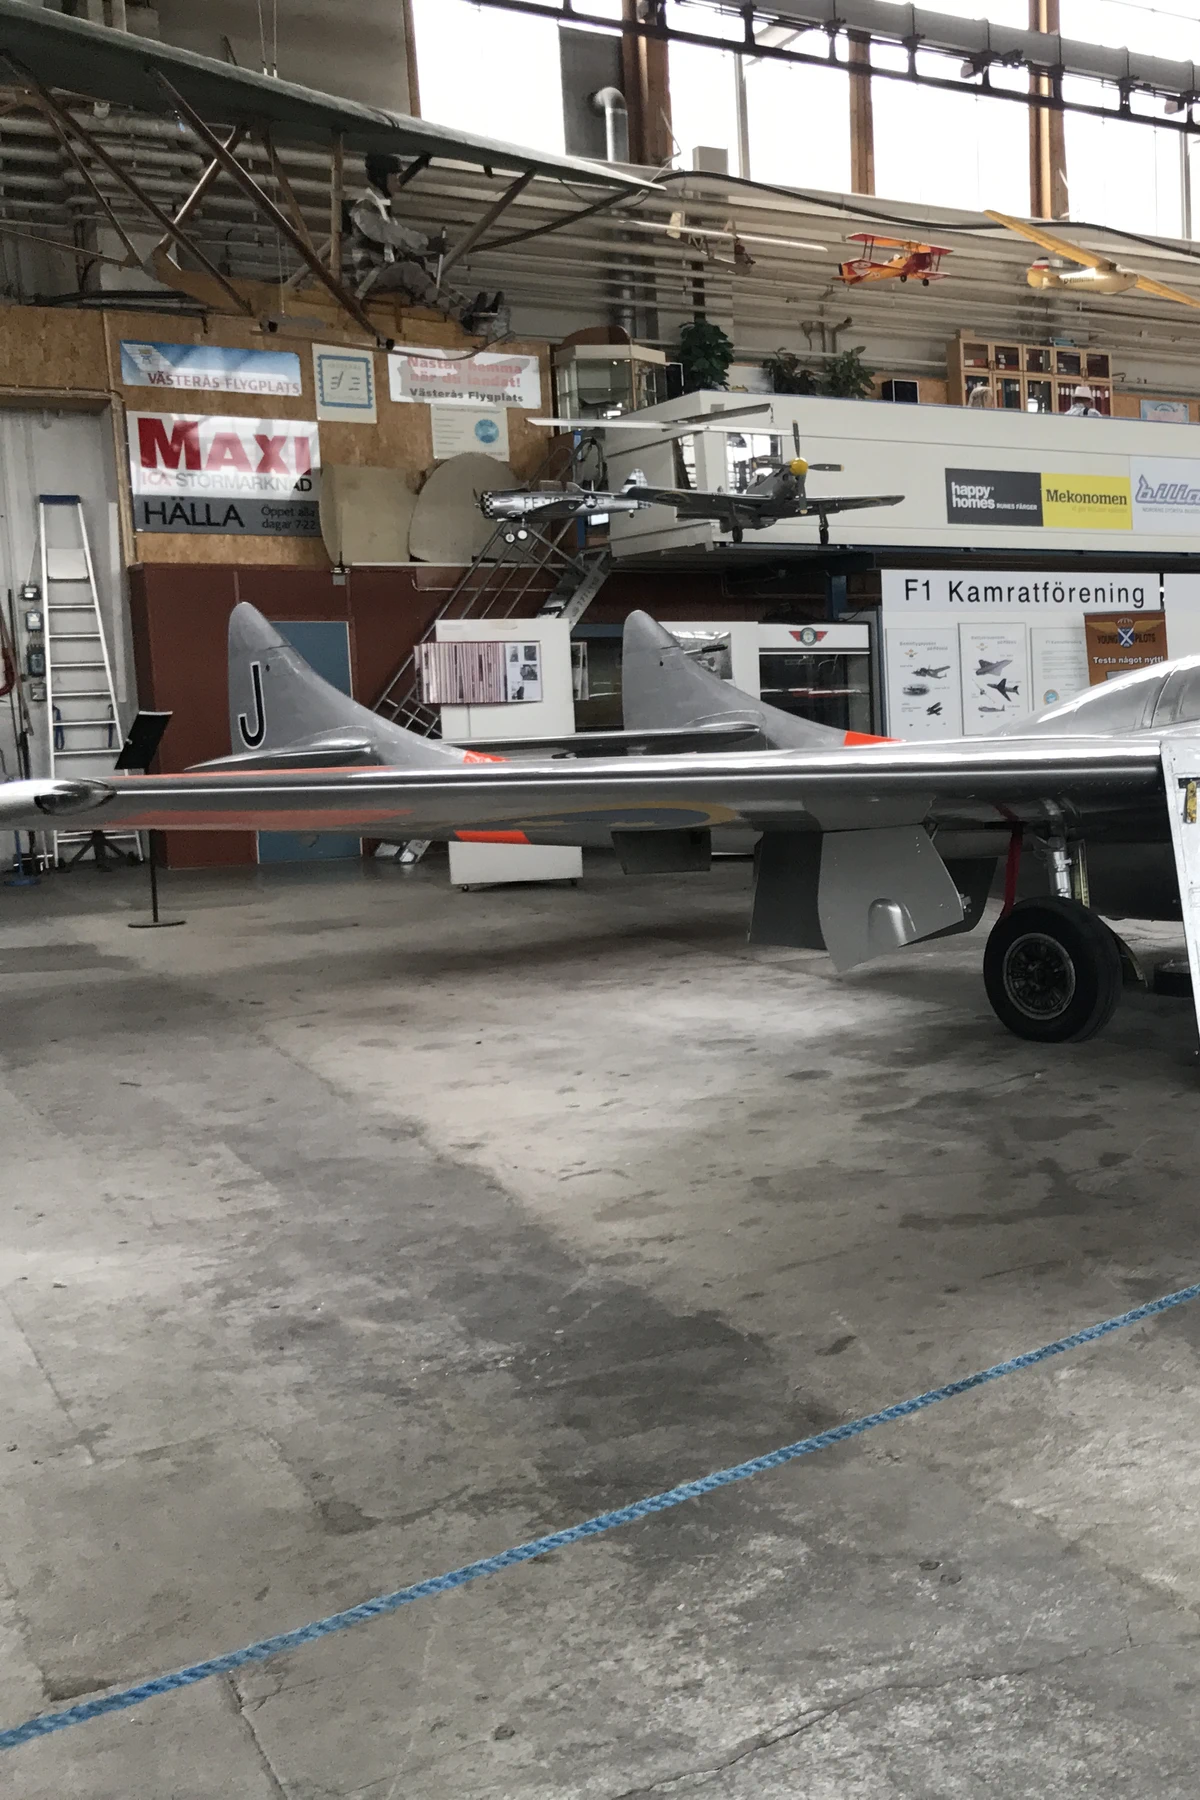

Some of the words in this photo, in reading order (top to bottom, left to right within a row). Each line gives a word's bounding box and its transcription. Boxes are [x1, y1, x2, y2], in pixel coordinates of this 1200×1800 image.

[148, 371, 220, 389] VÄSTERÅS
[225, 378, 300, 394] FLYGPLATS
[410, 371, 434, 383] när
[443, 374, 461, 384] du
[468, 376, 521, 388] landat!
[410, 388, 464, 399] Västerås
[468, 391, 524, 403] Flygplats
[138, 417, 312, 476] MAXI
[142, 472, 171, 487] ICA
[176, 472, 312, 492] STORMARKNAD
[951, 481, 991, 500] happy
[952, 495, 995, 510] homes
[1046, 489, 1128, 506] Mekonomen
[144, 497, 245, 528] HÄLLA
[261, 503, 294, 519] Öppet
[262, 518, 291, 531] dagar
[905, 579, 931, 601] F1
[948, 581, 1145, 609] Kamratförening
[1135, 633, 1156, 643] PILOTS
[1093, 656, 1117, 664] Testa
[1118, 656, 1142, 665] något
[238, 661, 266, 749] J
